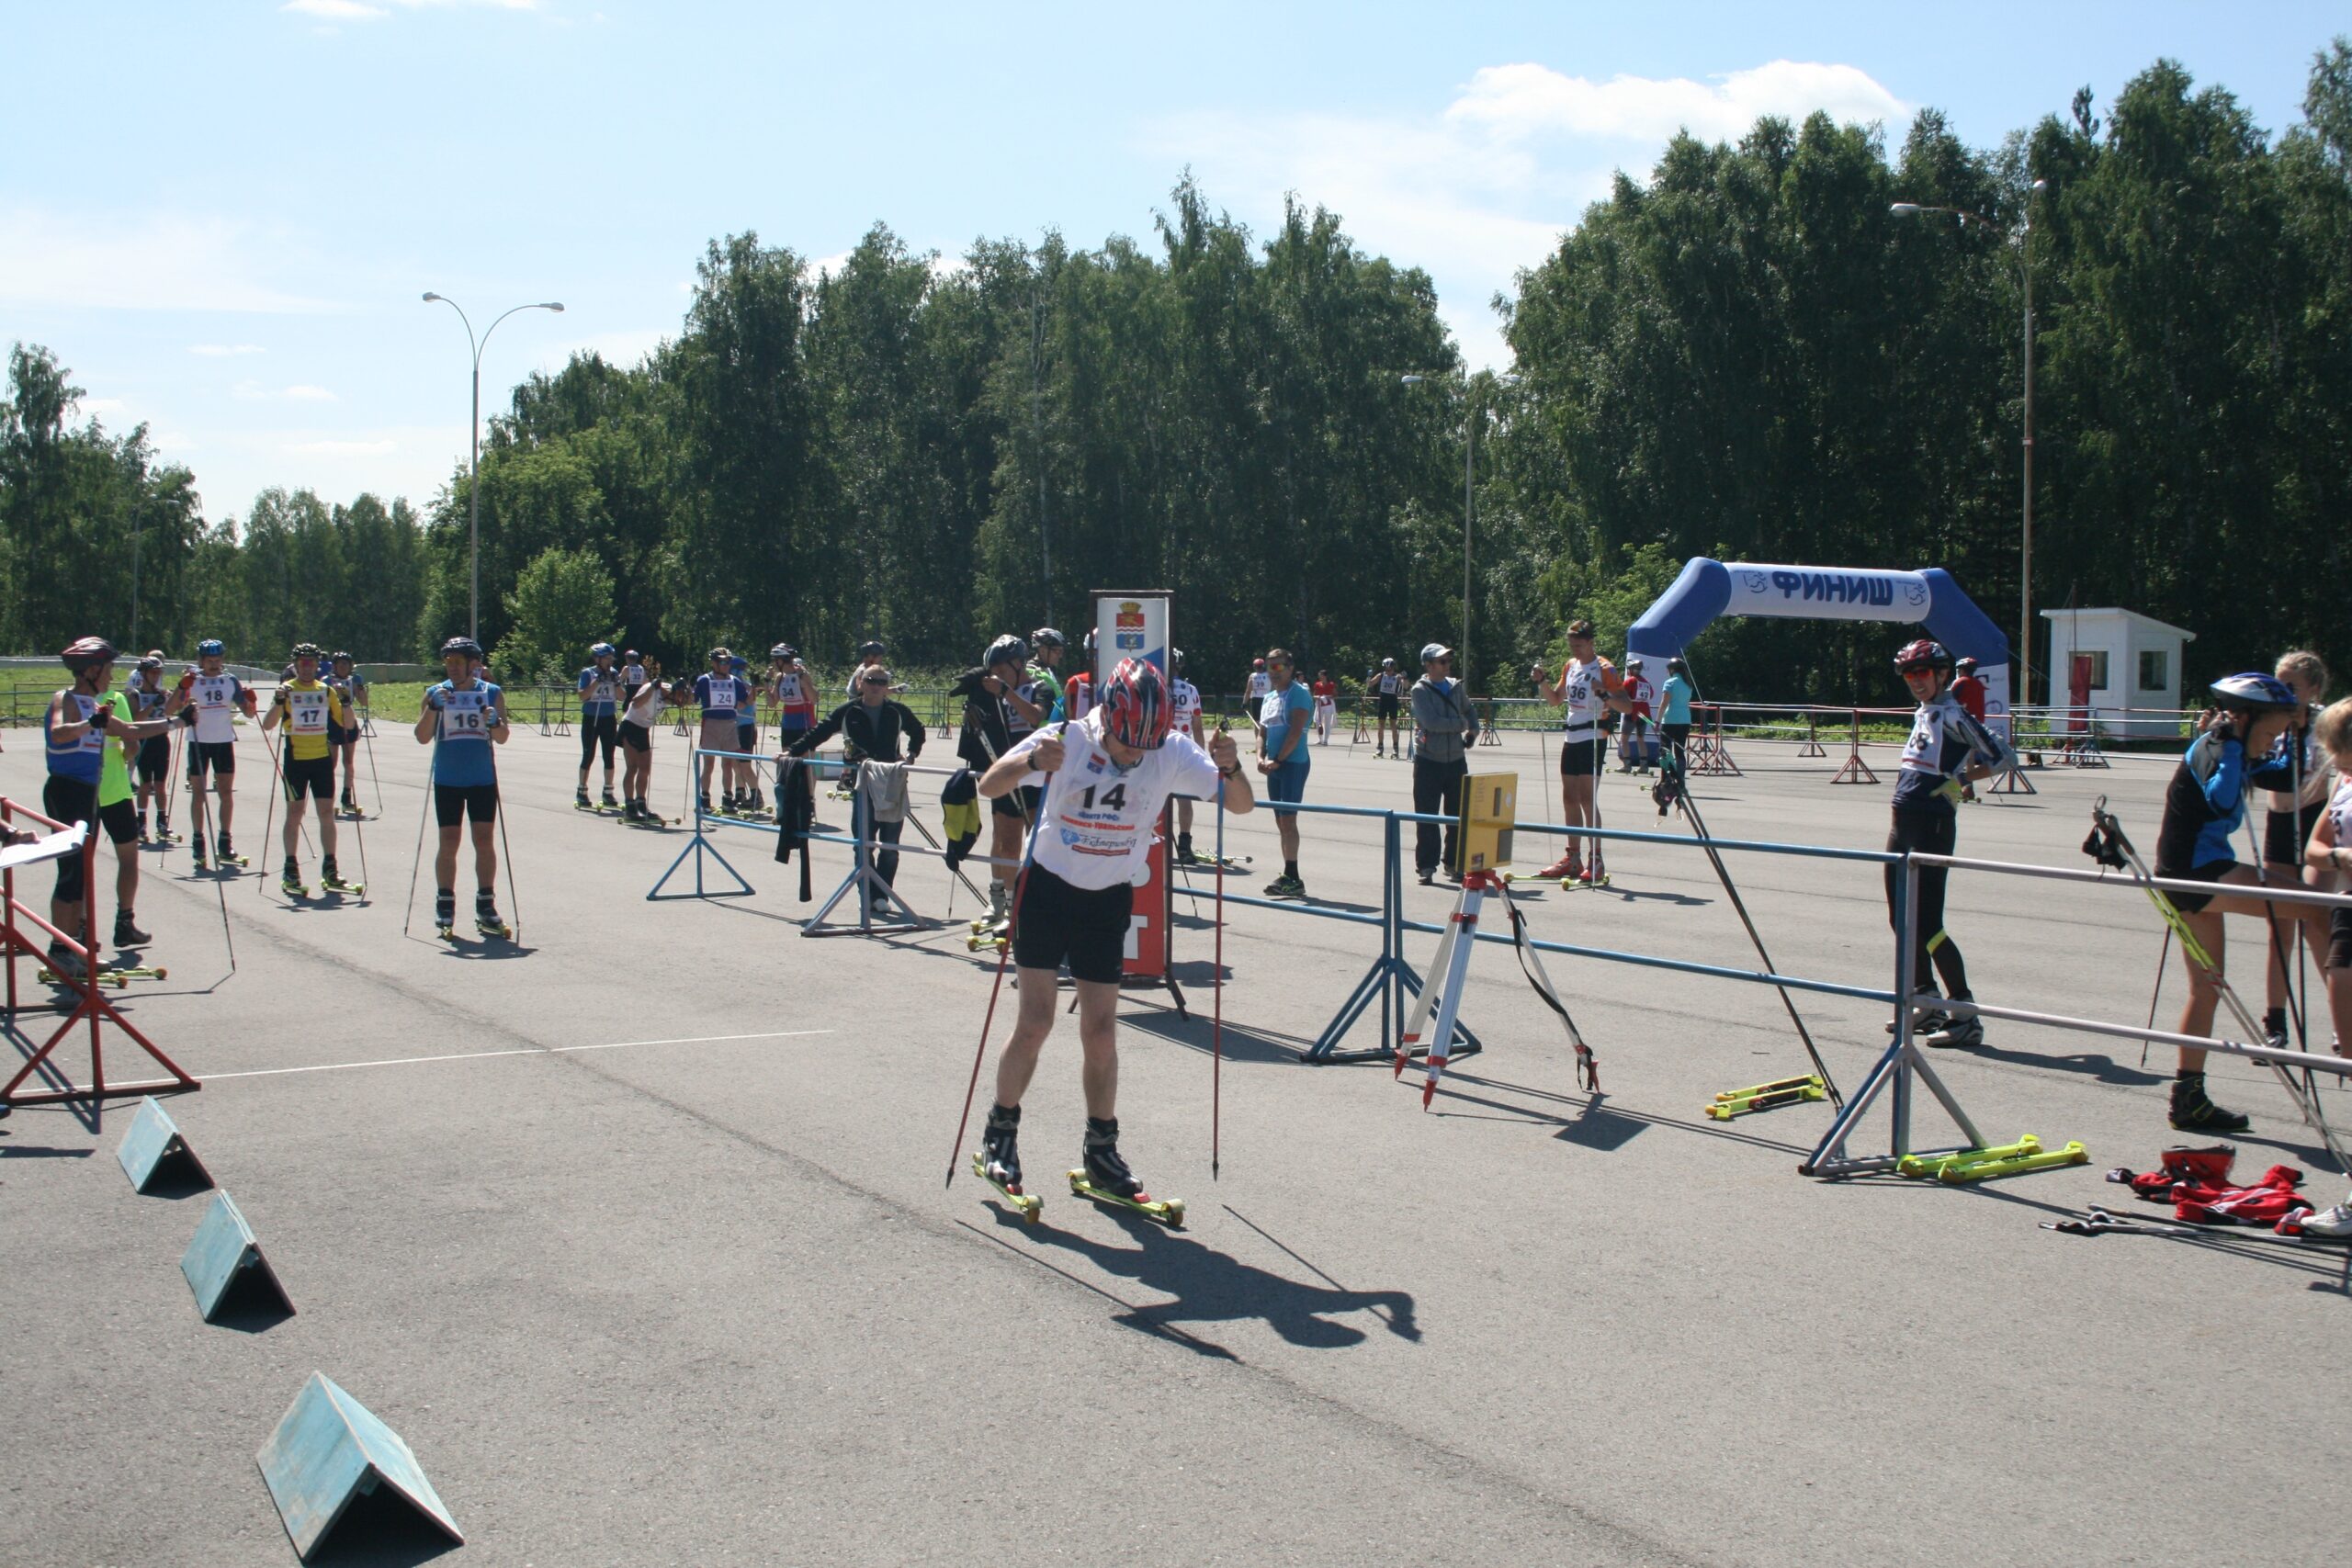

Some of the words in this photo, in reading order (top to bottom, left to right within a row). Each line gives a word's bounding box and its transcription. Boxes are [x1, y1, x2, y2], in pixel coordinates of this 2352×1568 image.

[1771, 570, 1894, 606] ФИНИШ
[204, 689, 223, 702] 18
[718, 693, 732, 704] 24
[782, 686, 795, 697] 34
[300, 708, 320, 723] 17
[454, 713, 480, 728] 16
[1080, 783, 1126, 811] 14
